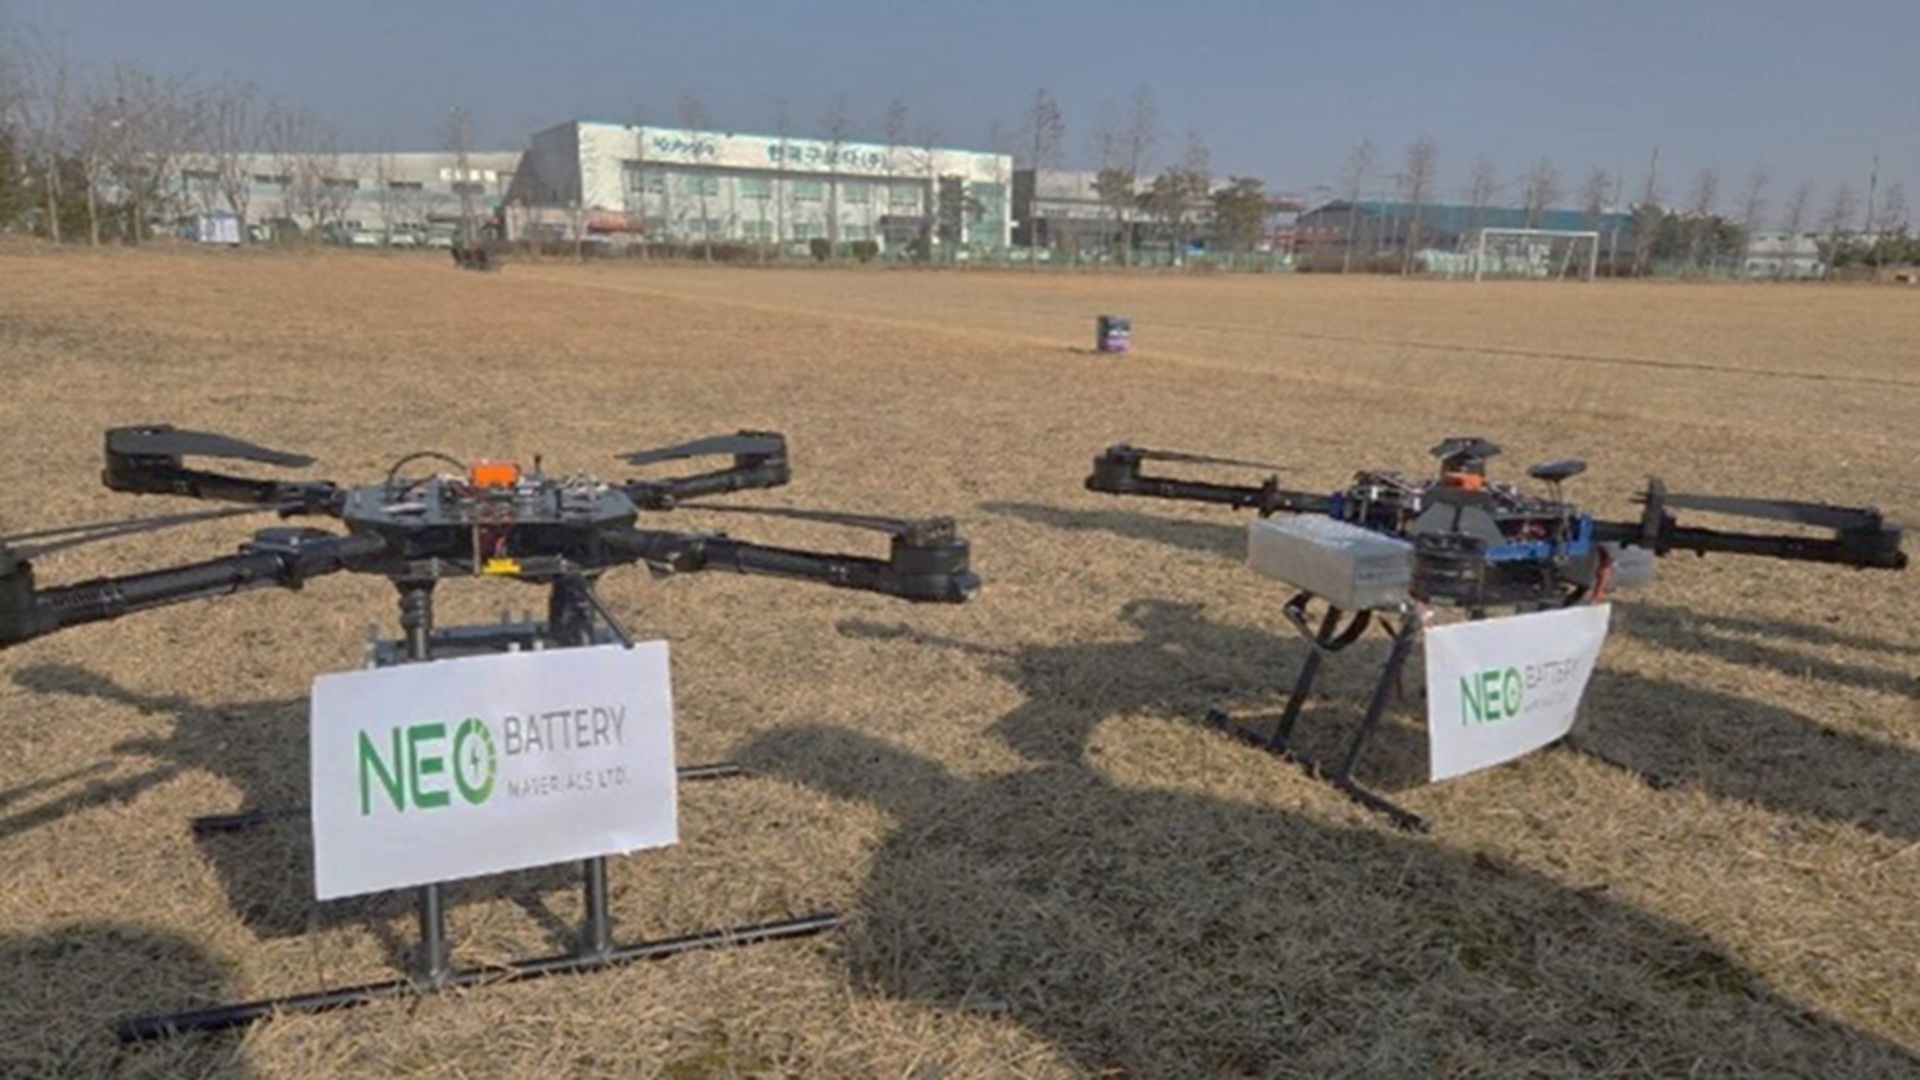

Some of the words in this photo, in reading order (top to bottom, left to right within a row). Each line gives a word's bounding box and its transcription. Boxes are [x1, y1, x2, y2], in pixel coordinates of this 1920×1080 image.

[1460, 665, 1523, 726] NEO
[359, 716, 497, 817] NEO
[504, 704, 626, 756] BATTERY
